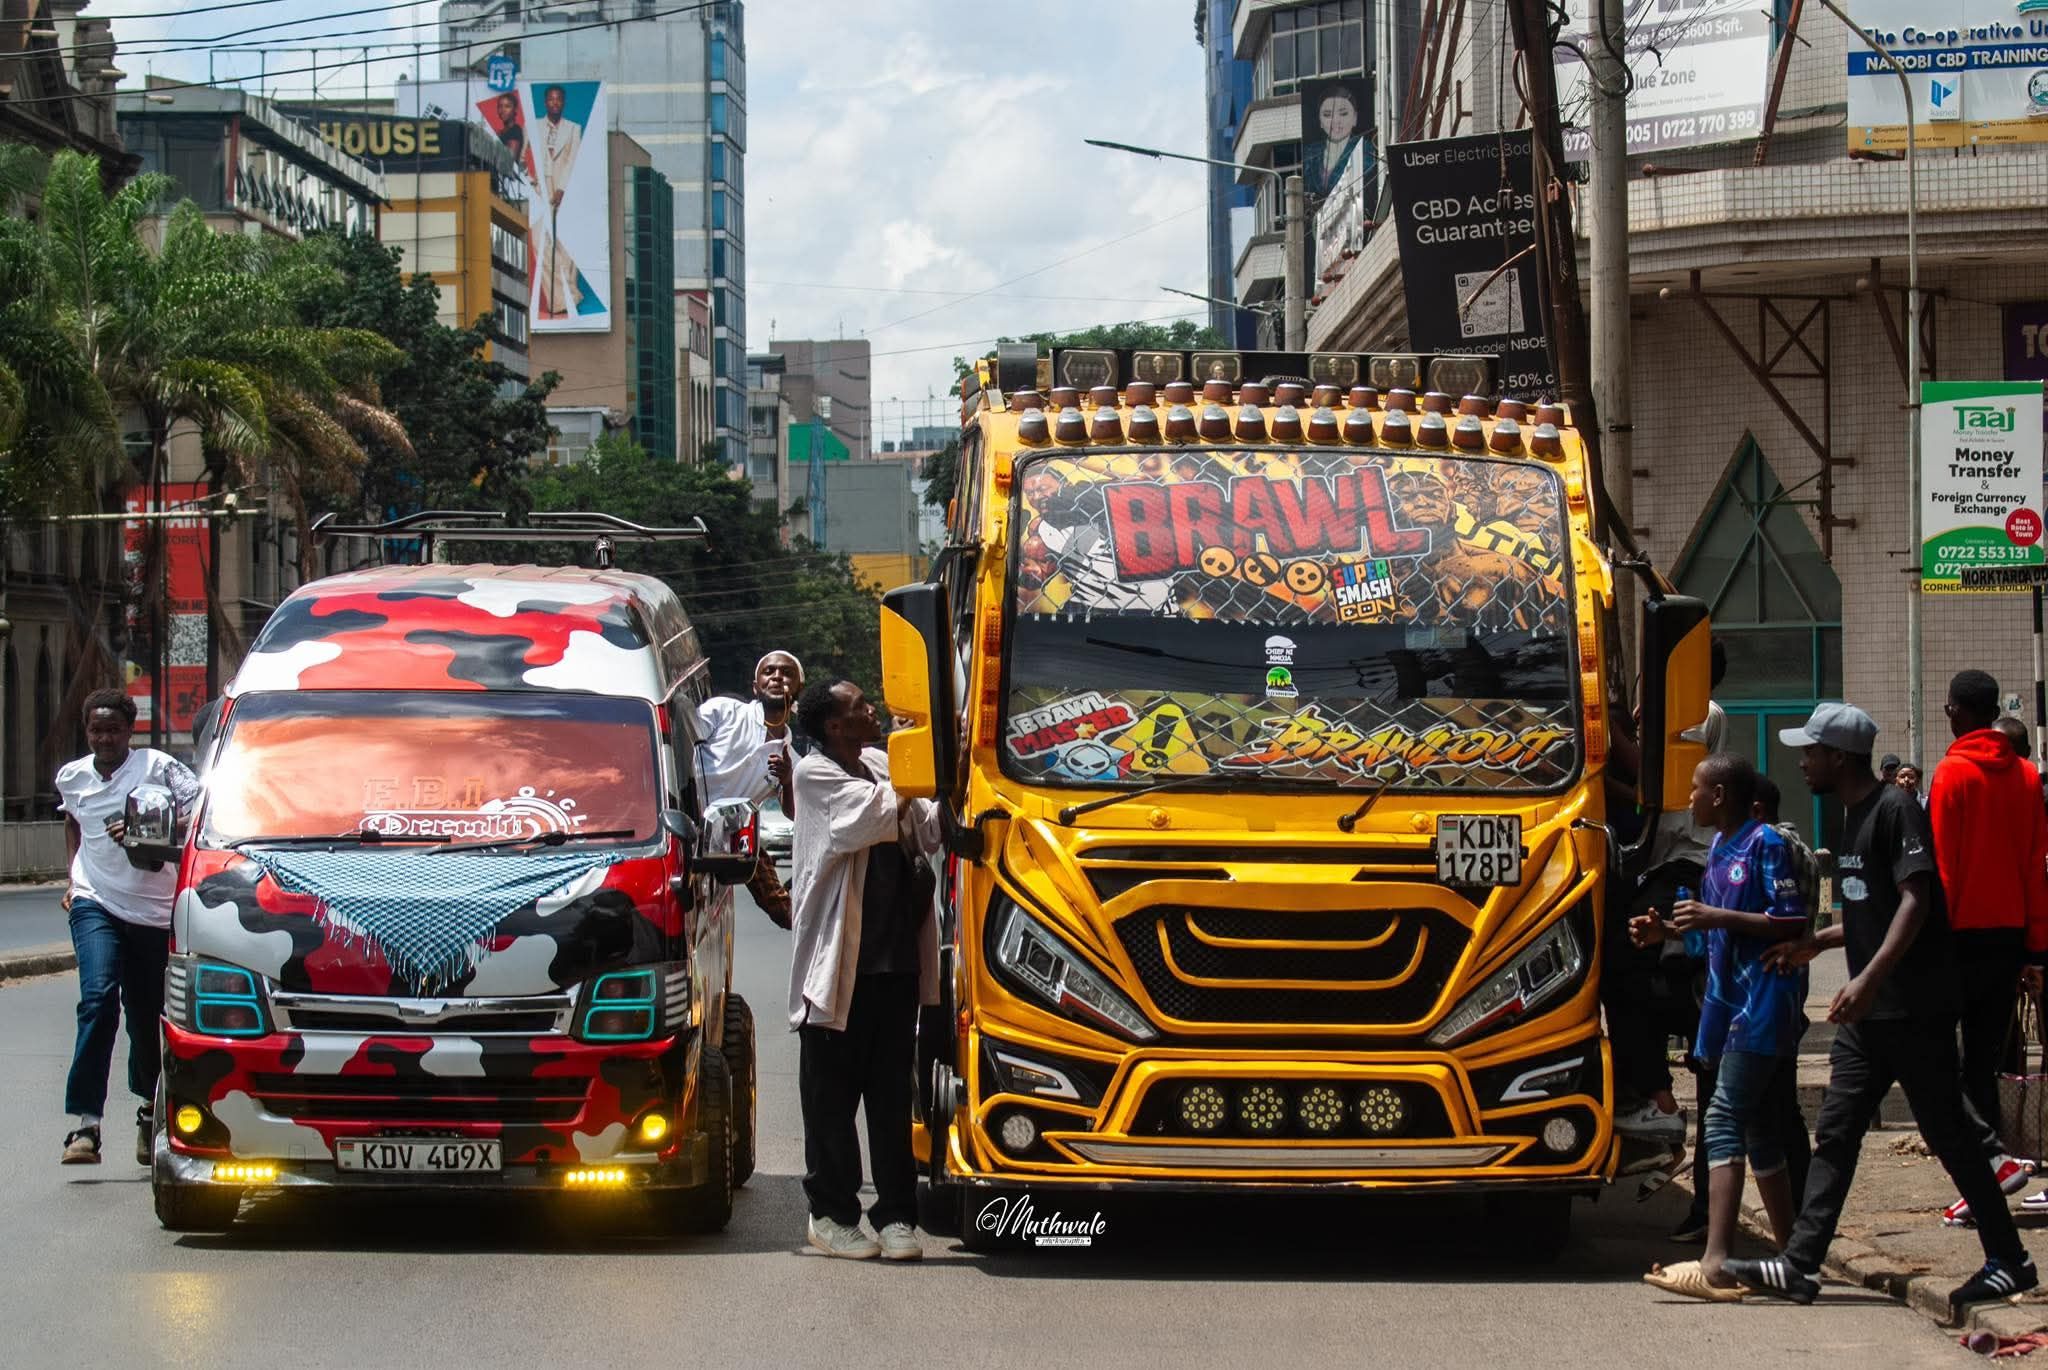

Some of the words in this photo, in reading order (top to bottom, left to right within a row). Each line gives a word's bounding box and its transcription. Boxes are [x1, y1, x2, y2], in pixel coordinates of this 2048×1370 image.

[1715, 17, 1743, 40] Sqft.
[1936, 53, 1967, 68] CBD
[1972, 48, 2048, 65] TRAINING
[1661, 69, 1697, 87] Zone
[1662, 117, 1697, 139] 0722
[1700, 114, 1726, 135] 770
[1729, 109, 1756, 131] 399
[320, 120, 441, 156] HOUSE
[1404, 151, 1441, 168] Uber
[1445, 143, 1500, 164] Electric
[1412, 198, 1461, 221] CBD
[1416, 217, 1536, 244] Guarantee
[1475, 340, 1506, 355] code
[1508, 372, 1543, 389] 50%
[1952, 406, 2017, 432] Taaj
[1955, 447, 2015, 465] Money
[1948, 463, 2021, 478] Transfer
[1980, 479, 1990, 490] &
[1931, 492, 1974, 506] Foreign
[1975, 492, 2027, 505] Currency
[1954, 503, 2007, 516] Exchange
[1103, 467, 1429, 580] BRAWL
[1938, 546, 1975, 559] 0722
[1978, 546, 2006, 559] 553
[2008, 546, 2030, 559] 131
[1331, 558, 1389, 588] SUPER
[1335, 577, 1393, 607] SMASH
[1339, 599, 1397, 622] CON
[1017, 694, 1107, 736] BRAWL
[1459, 818, 1513, 850] KDN
[1444, 852, 1513, 882] 178P
[362, 1143, 413, 1169] KDV
[427, 1143, 495, 1169] 409X
